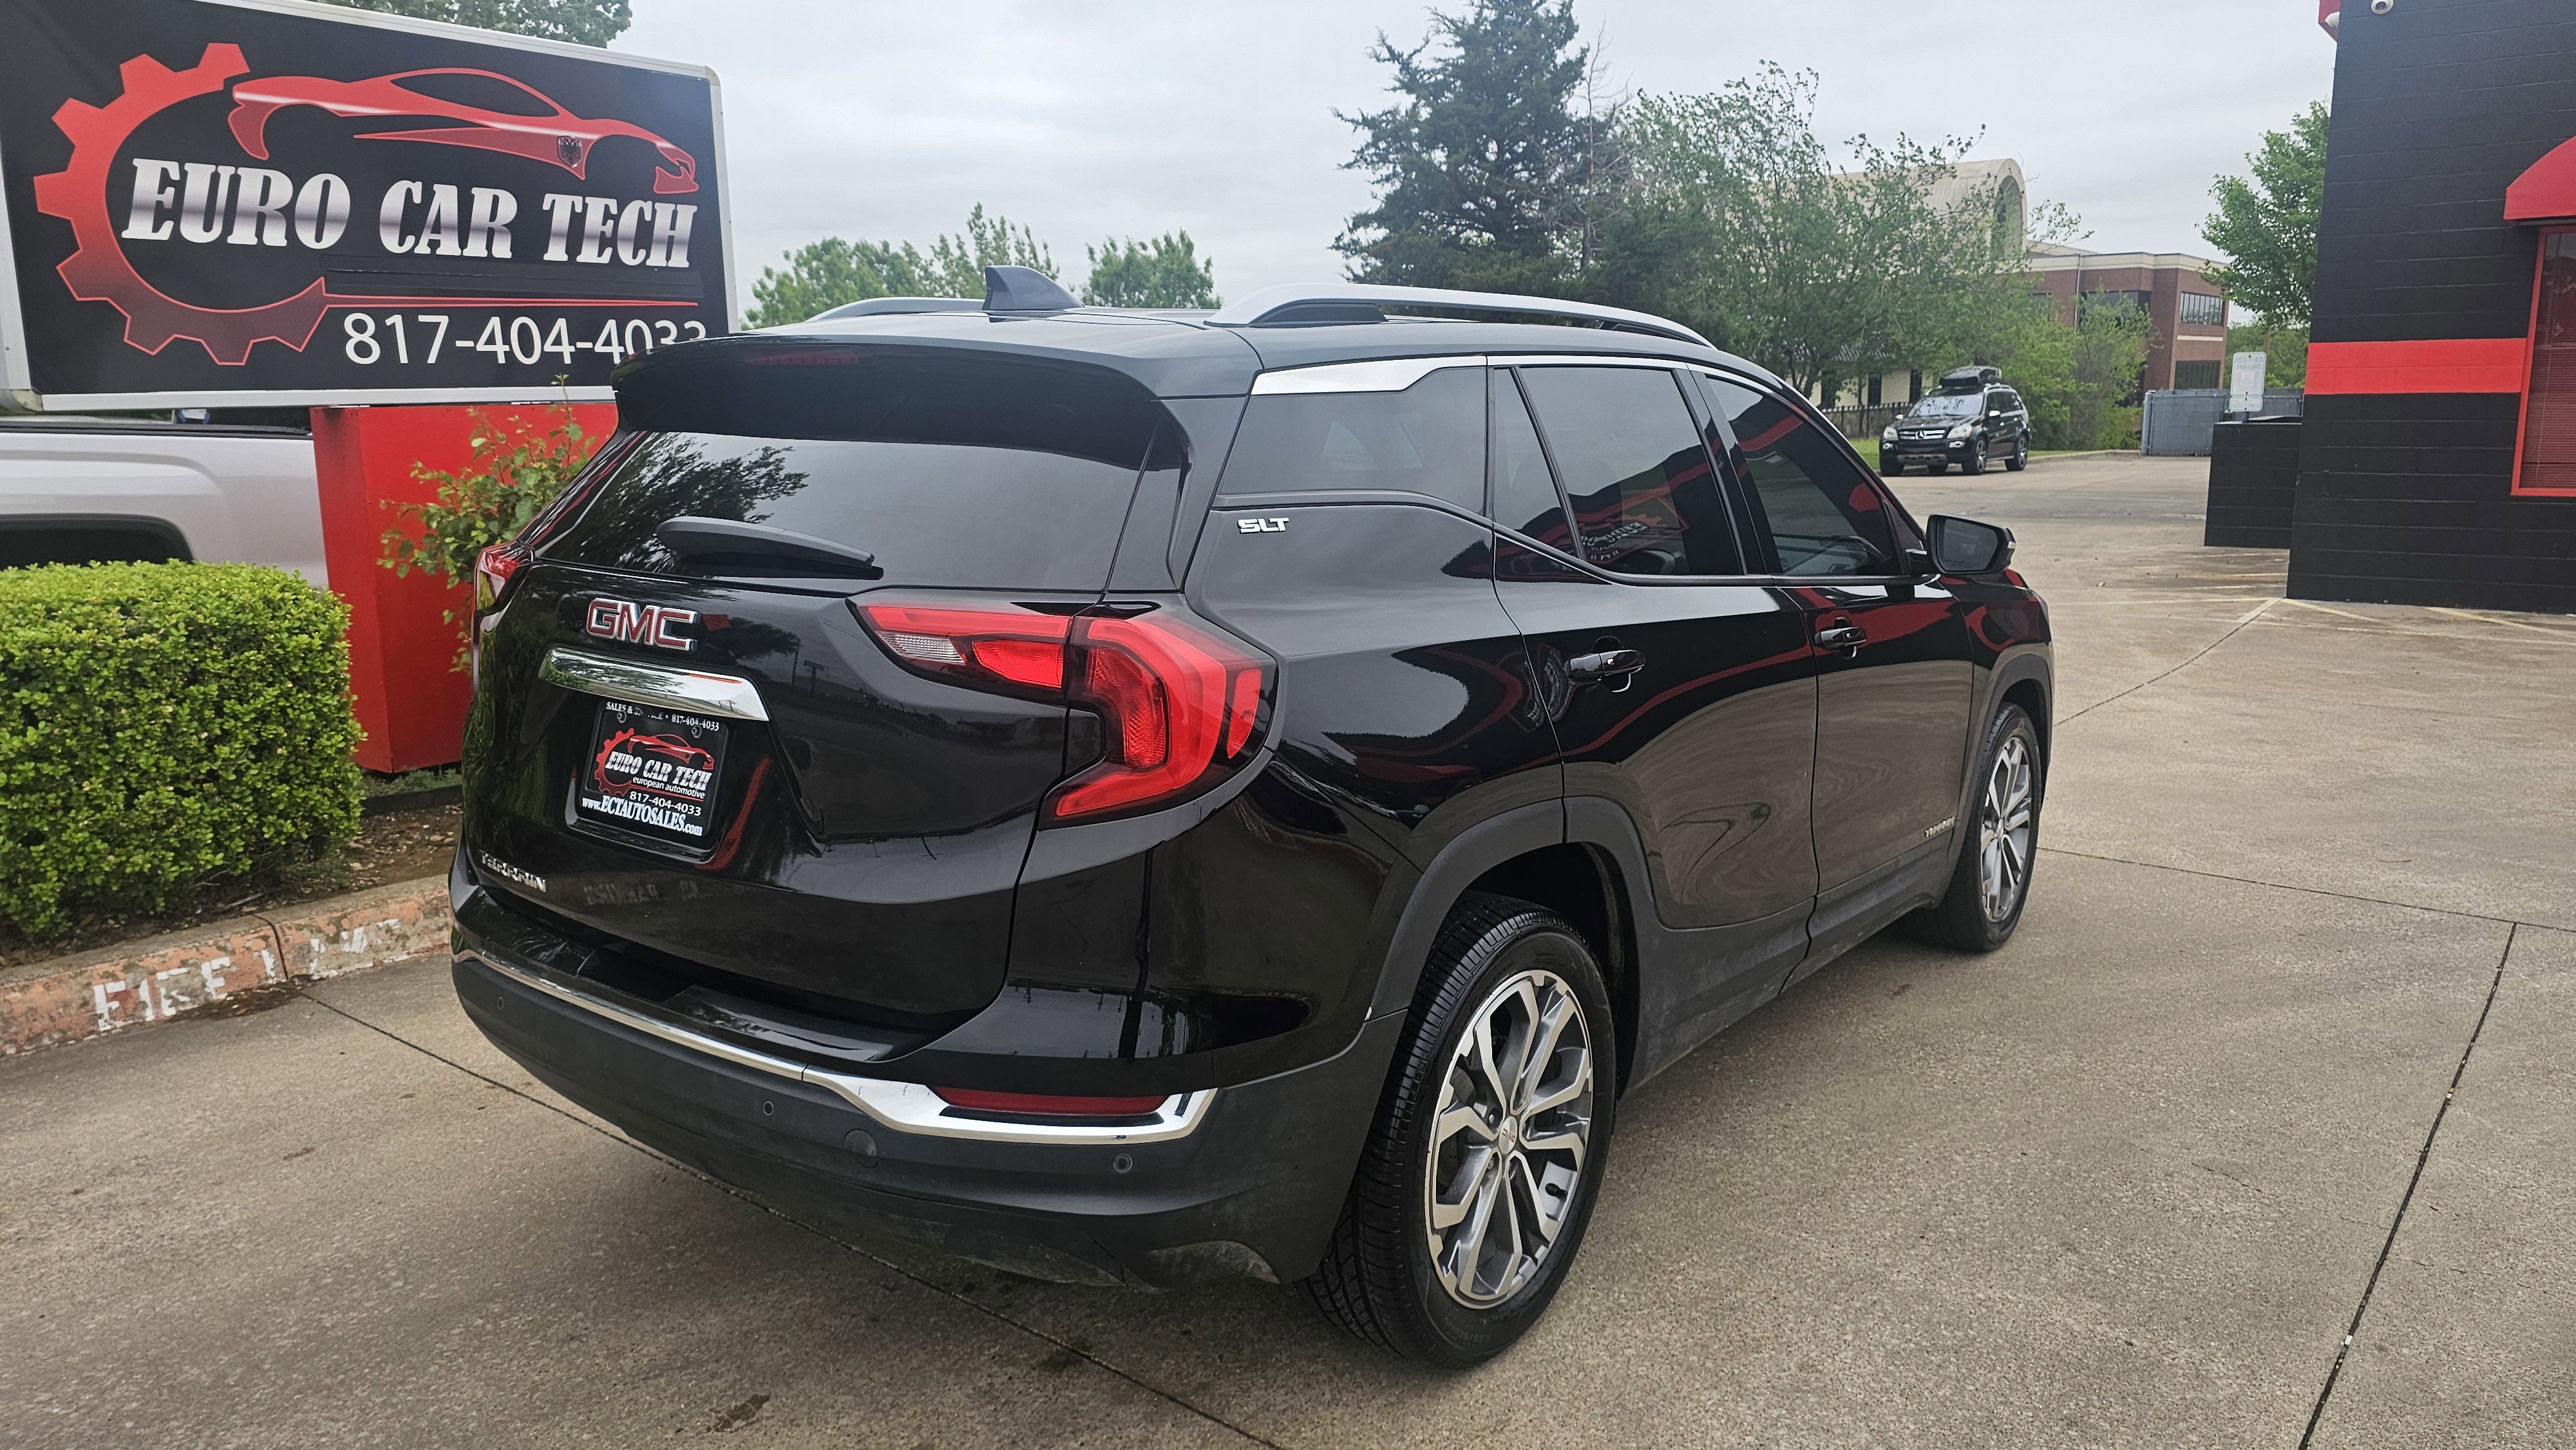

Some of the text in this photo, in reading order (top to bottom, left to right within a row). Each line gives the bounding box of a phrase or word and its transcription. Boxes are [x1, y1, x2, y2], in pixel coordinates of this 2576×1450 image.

[121, 158, 697, 268] EURO CAR TECH
[1238, 517, 1290, 533] SLT
[587, 598, 698, 652] GMC
[606, 701, 627, 712] SALES
[627, 705, 633, 715] &
[671, 713, 719, 731] 817-404-4033
[605, 751, 712, 791] EURO CAR TECH
[632, 776, 706, 799] european automotive
[582, 795, 703, 836] www.ECTAUTOSALES.com
[629, 791, 702, 816] 817-404-4033
